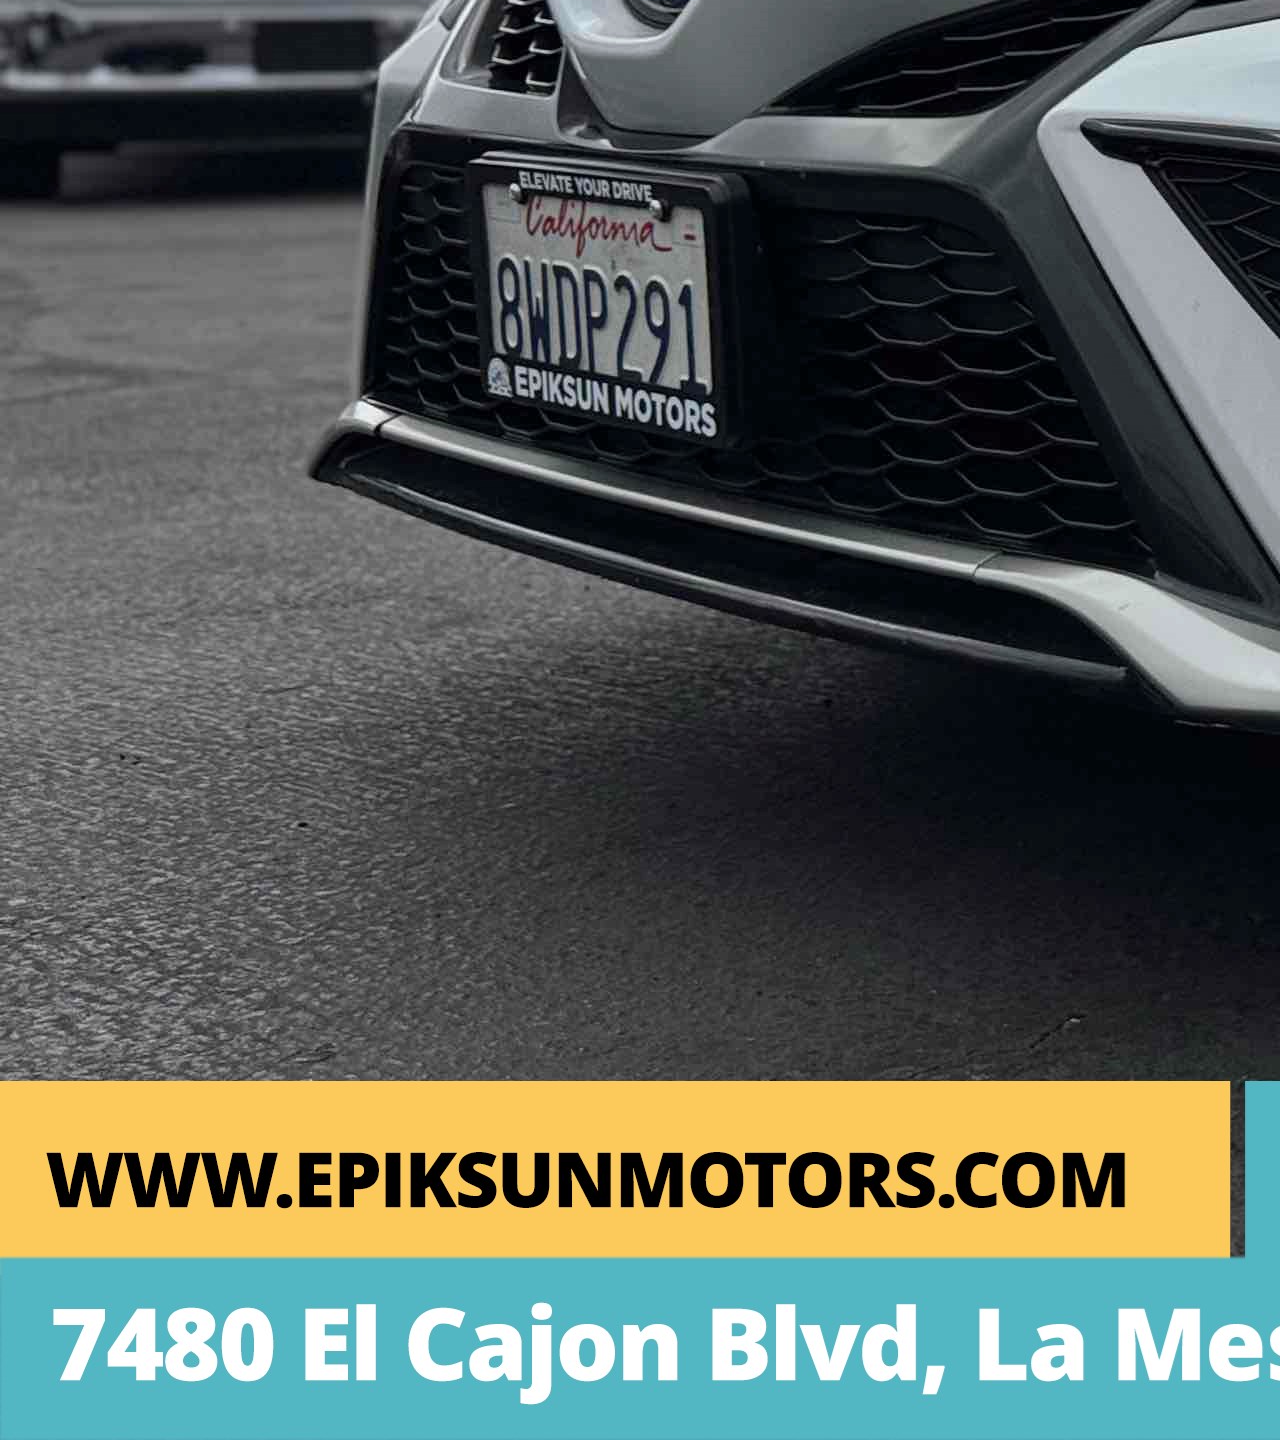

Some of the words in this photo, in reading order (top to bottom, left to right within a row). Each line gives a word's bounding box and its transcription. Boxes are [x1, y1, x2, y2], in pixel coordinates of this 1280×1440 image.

[518, 171, 574, 194] ELEVATE
[574, 175, 613, 198] YOUR
[612, 180, 653, 203] DRIVE
[526, 194, 673, 258] California
[497, 255, 708, 394] 8WDP291
[514, 365, 611, 416] EPIKSUN
[614, 384, 718, 438] MOTORS
